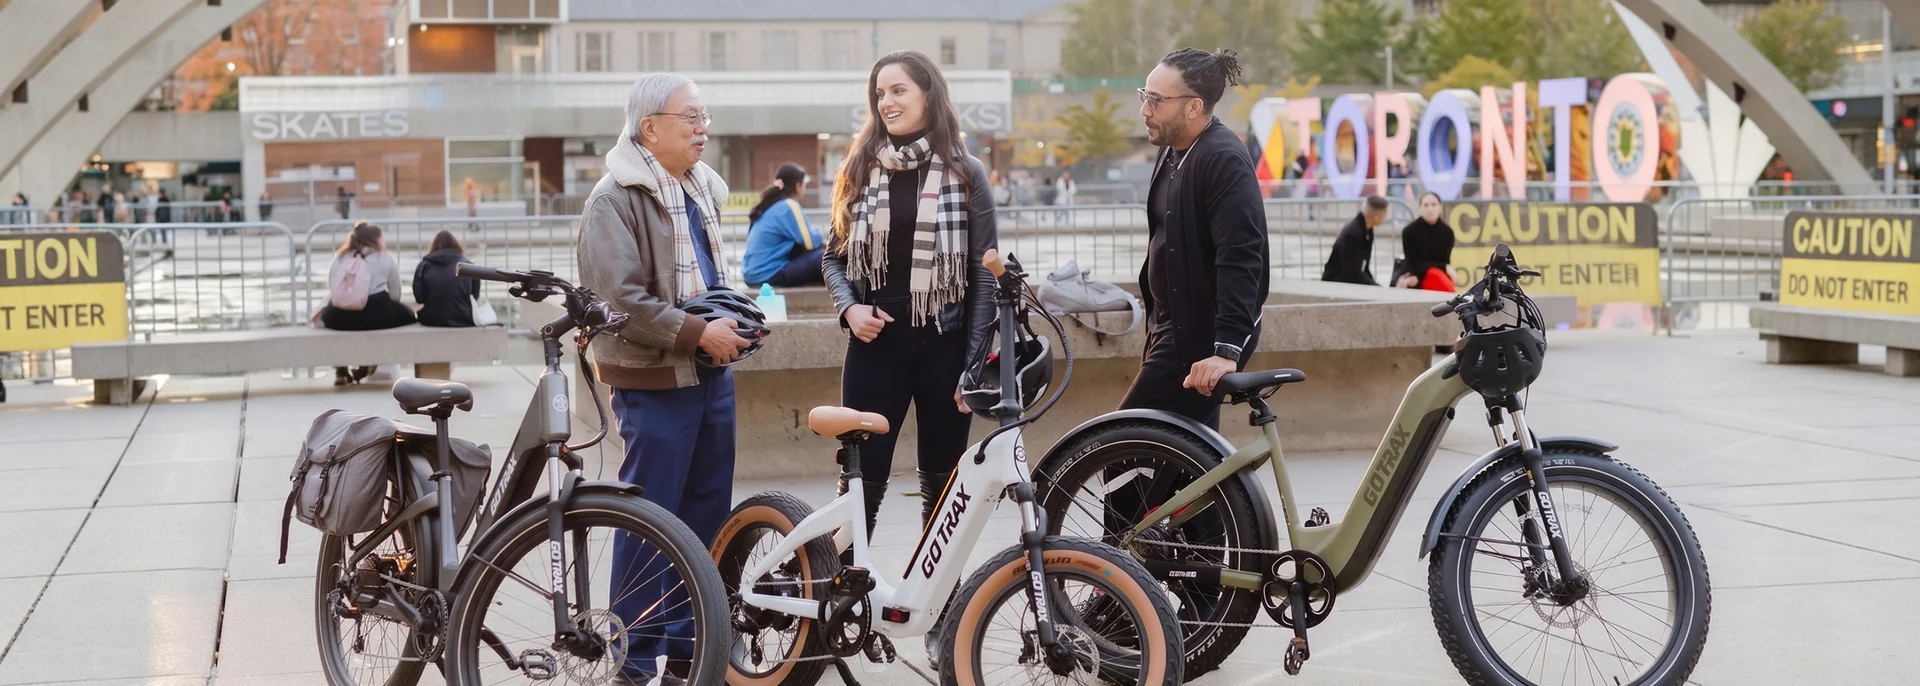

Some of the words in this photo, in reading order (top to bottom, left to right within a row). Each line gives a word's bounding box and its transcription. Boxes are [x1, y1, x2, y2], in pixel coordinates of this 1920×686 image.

[252, 109, 409, 140] SKATES
[1276, 77, 1660, 202] TORONTO
[1450, 202, 1636, 244] CAUTION
[1792, 217, 1912, 258] CAUTION
[0, 237, 98, 280] TION
[1559, 262, 1639, 287] ENTER
[1788, 274, 1808, 296] DO
[1814, 276, 1848, 299] NOT
[1852, 278, 1909, 304] ENTER
[26, 303, 105, 330] ENTER
[490, 451, 517, 517] GOTRAX
[1362, 422, 1411, 508] GOTRAX
[1538, 491, 1563, 539] GOTRAX
[550, 540, 564, 595] GOTRAX
[1031, 570, 1049, 623] GOTRAX
